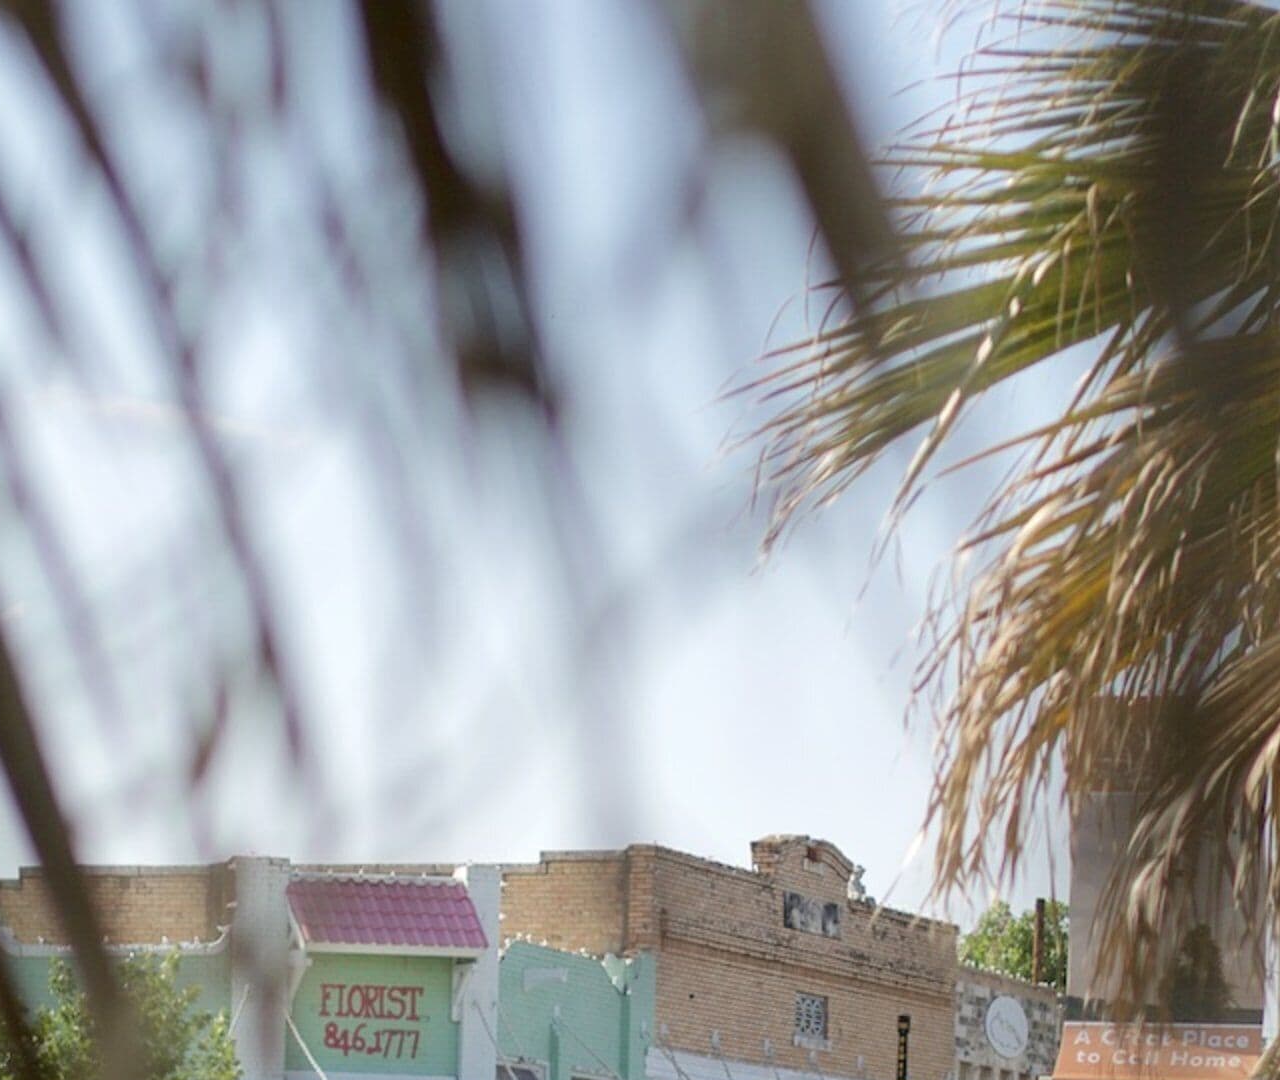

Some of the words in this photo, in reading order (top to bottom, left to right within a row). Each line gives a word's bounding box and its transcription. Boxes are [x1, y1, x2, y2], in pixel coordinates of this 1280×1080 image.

[319, 983, 424, 1021] FLORIST
[1075, 1029, 1091, 1046] A
[1183, 1029, 1249, 1048] Place
[1076, 1050, 1101, 1064] to
[1171, 1051, 1241, 1068] Home
